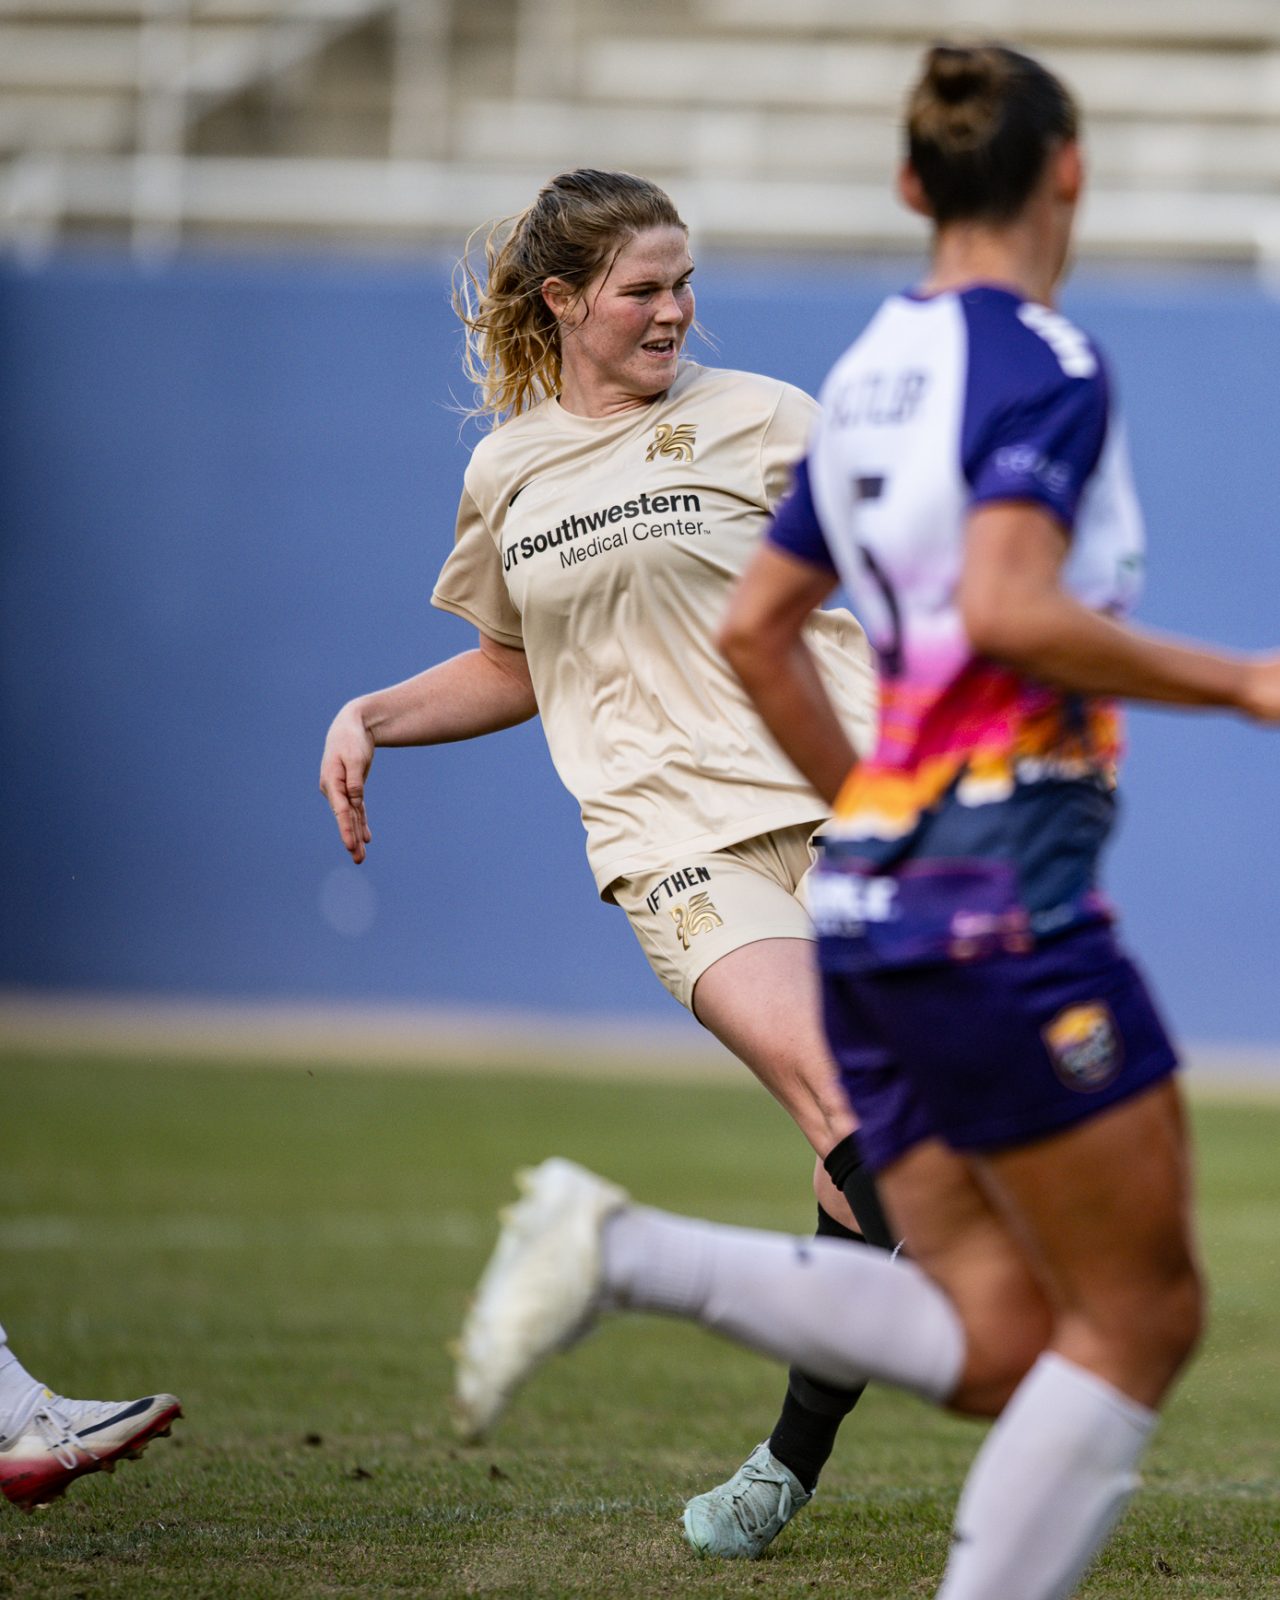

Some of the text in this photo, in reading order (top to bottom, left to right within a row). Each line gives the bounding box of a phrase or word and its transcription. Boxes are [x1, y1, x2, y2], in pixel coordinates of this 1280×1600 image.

[520, 493, 701, 559] Southwestern
[560, 526, 628, 569] Medical
[646, 866, 711, 916] IF THEN
